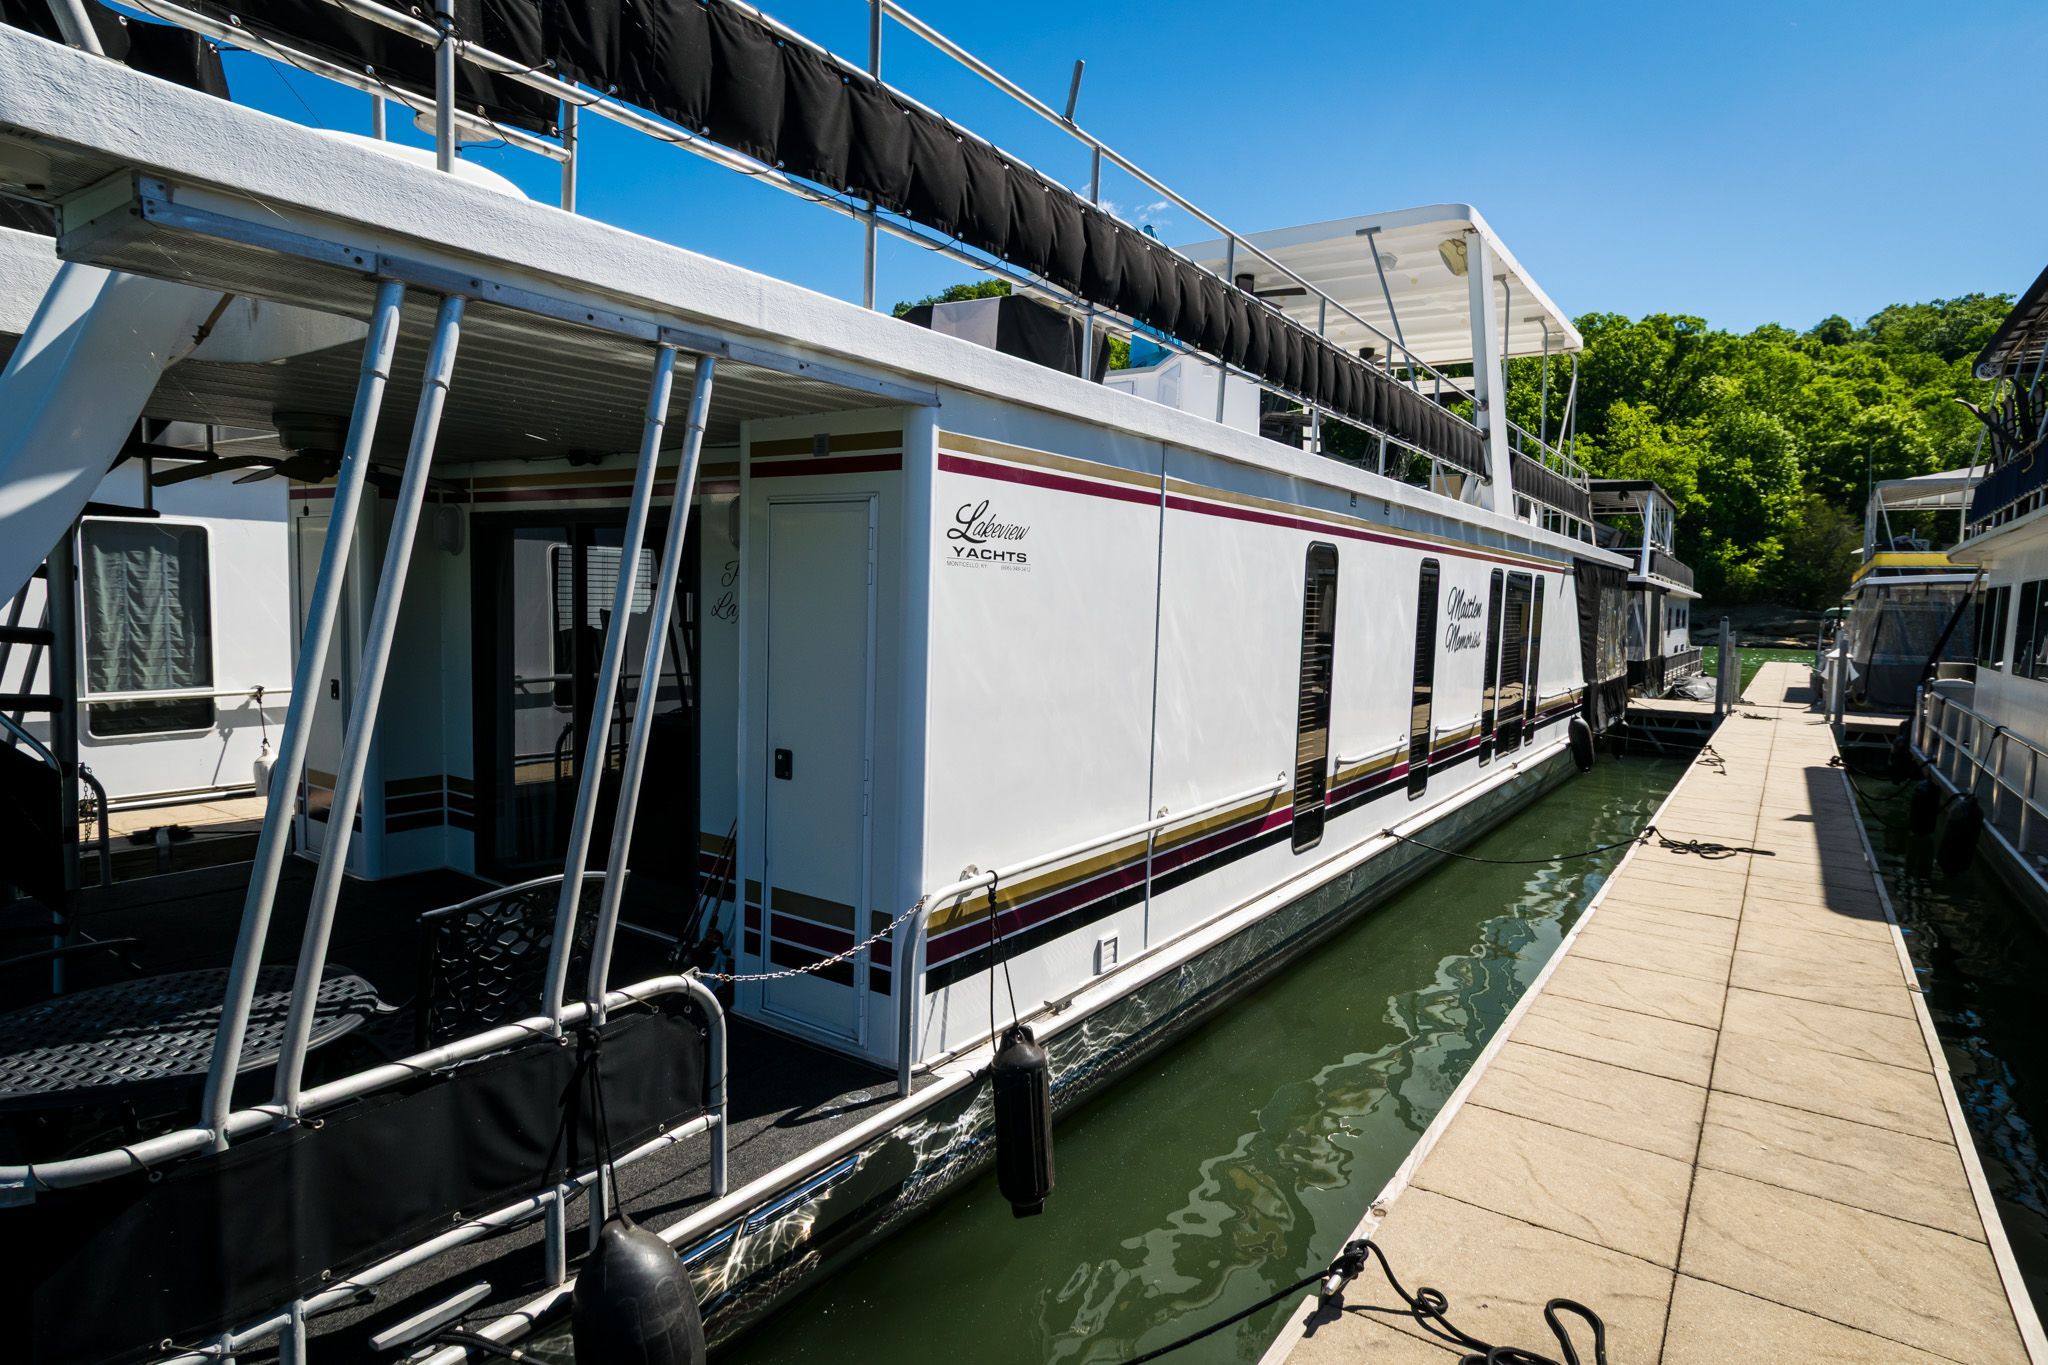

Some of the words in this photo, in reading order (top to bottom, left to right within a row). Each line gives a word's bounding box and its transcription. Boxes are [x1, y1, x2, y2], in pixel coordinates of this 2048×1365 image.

[947, 500, 1030, 543] Lakeview
[952, 546, 1027, 563] YACHTS
[1445, 622, 1481, 653] Memories
